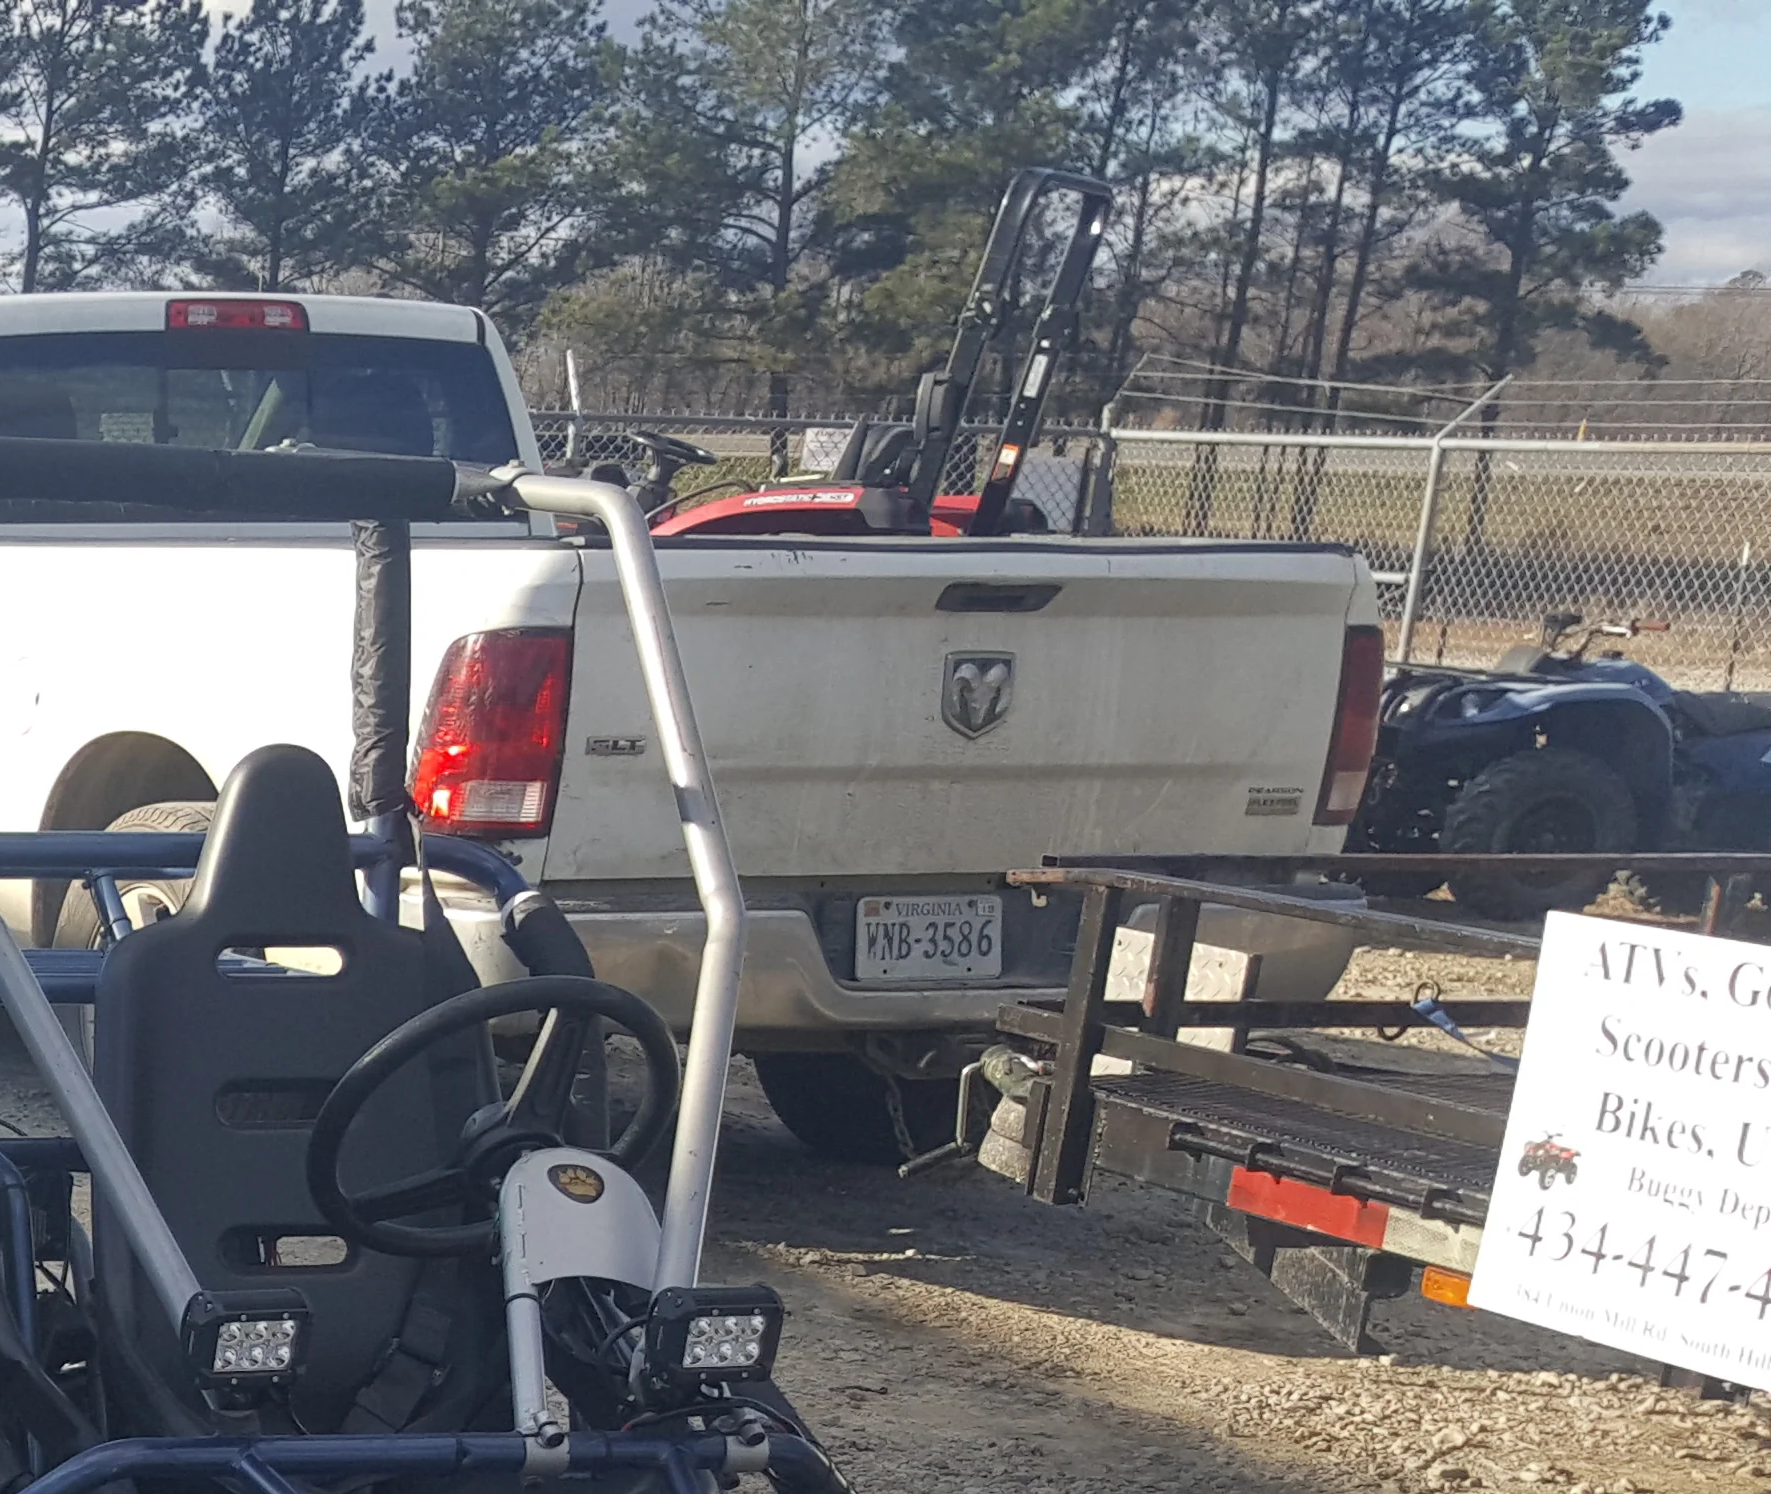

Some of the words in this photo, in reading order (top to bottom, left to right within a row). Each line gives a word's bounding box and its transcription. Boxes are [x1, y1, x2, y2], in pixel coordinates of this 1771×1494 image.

[895, 902, 963, 917] VIRGINIA
[865, 920, 993, 961] WNB-3586
[1728, 961, 1771, 1010] G
